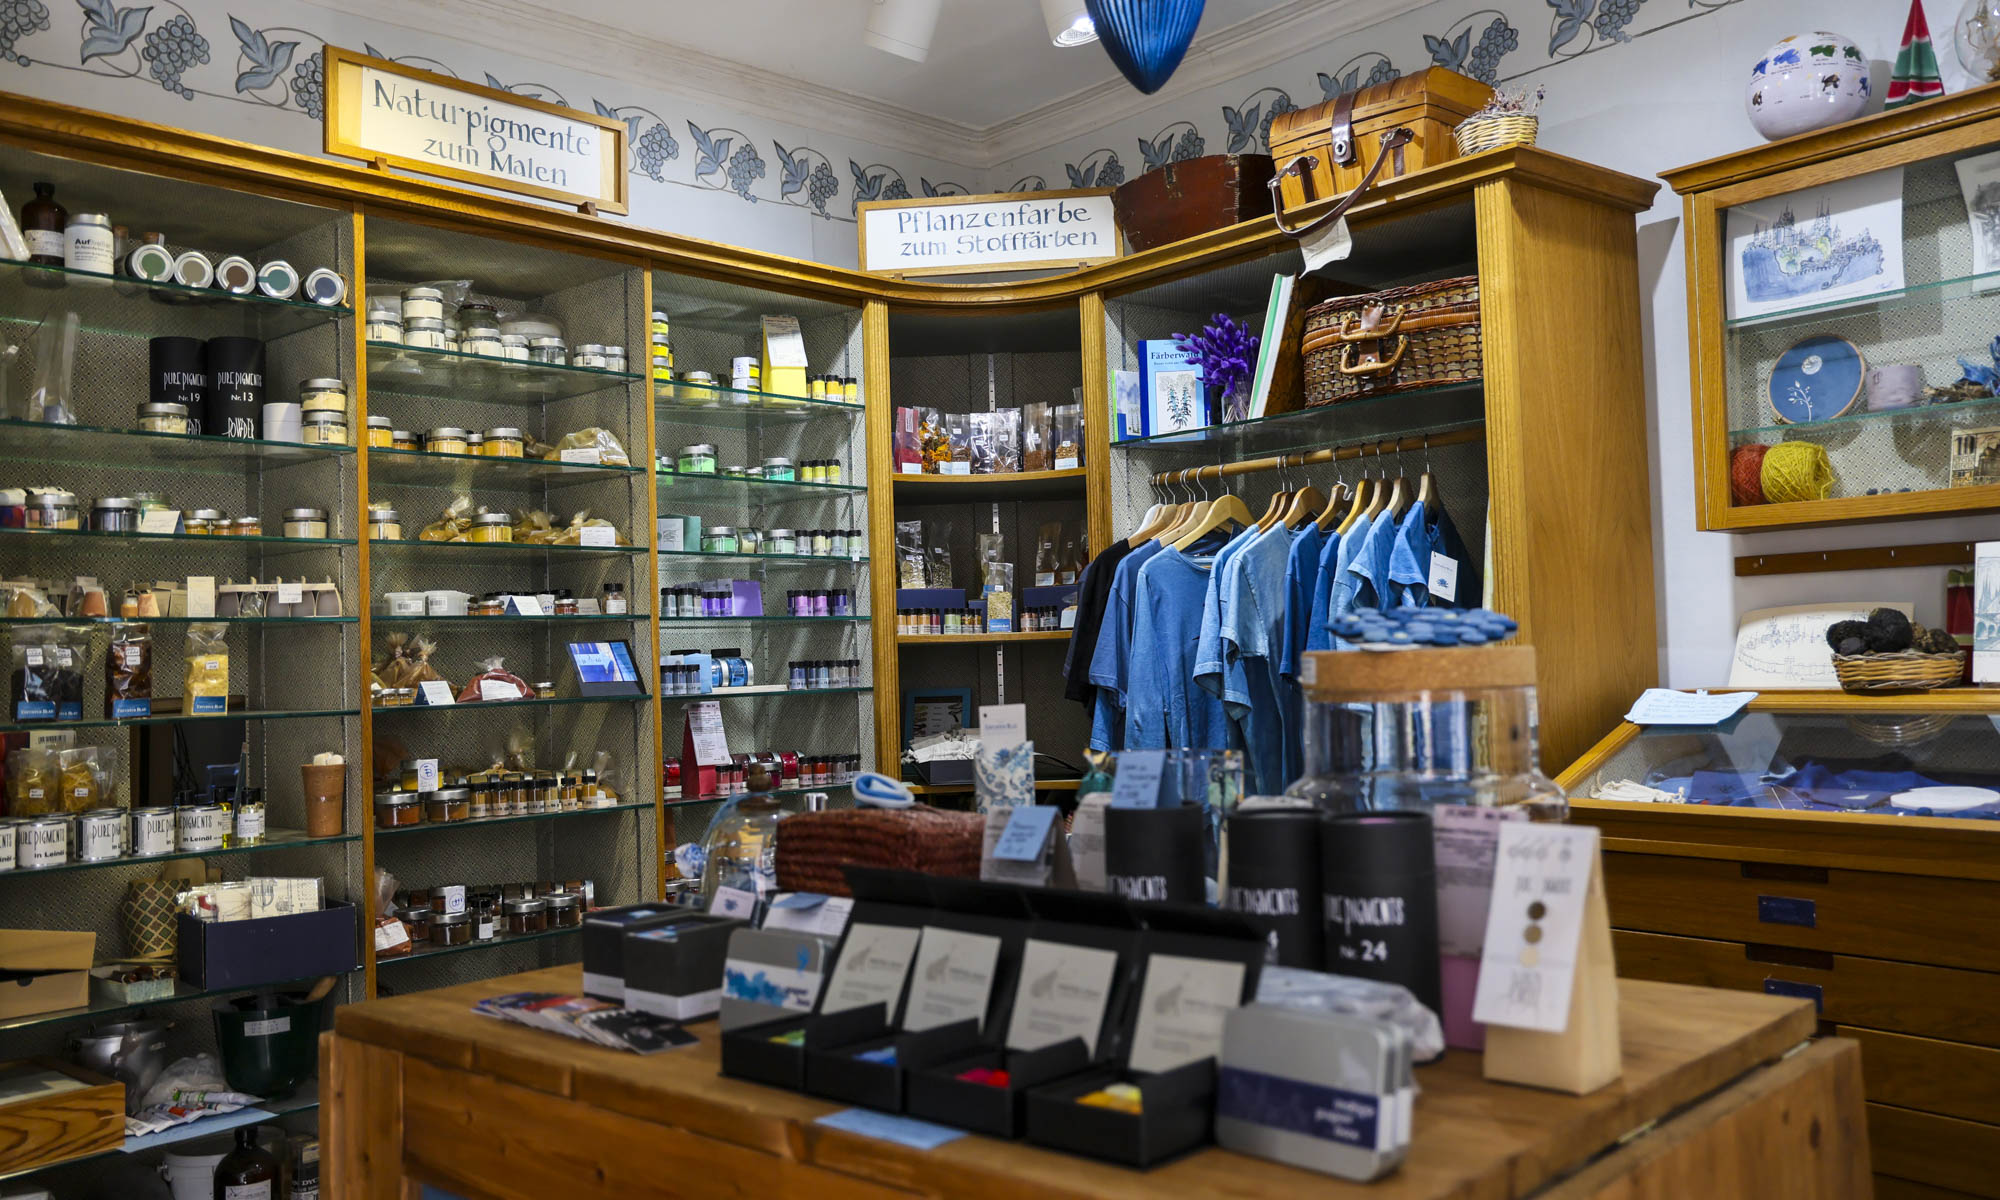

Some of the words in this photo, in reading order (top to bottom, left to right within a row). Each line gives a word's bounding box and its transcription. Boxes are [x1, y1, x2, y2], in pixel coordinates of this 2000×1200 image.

[373, 78, 591, 156] Naturpigmente
[423, 138, 480, 167] zum
[490, 151, 568, 187] Malen
[897, 200, 1092, 234] Pflanzenfarbe
[900, 240, 947, 257] zum
[956, 230, 1099, 255] Stofffärben
[163, 371, 181, 391] PURE
[182, 372, 207, 391] PIGMEN
[217, 371, 234, 391] PURE
[190, 391, 201, 402] 19
[243, 391, 254, 402] 13
[92, 823, 111, 845] PURE
[147, 820, 166, 840] PURE
[182, 815, 213, 834] PIGMENTS
[34, 828, 65, 851] PIGMENT
[1360, 939, 1388, 961] 24
